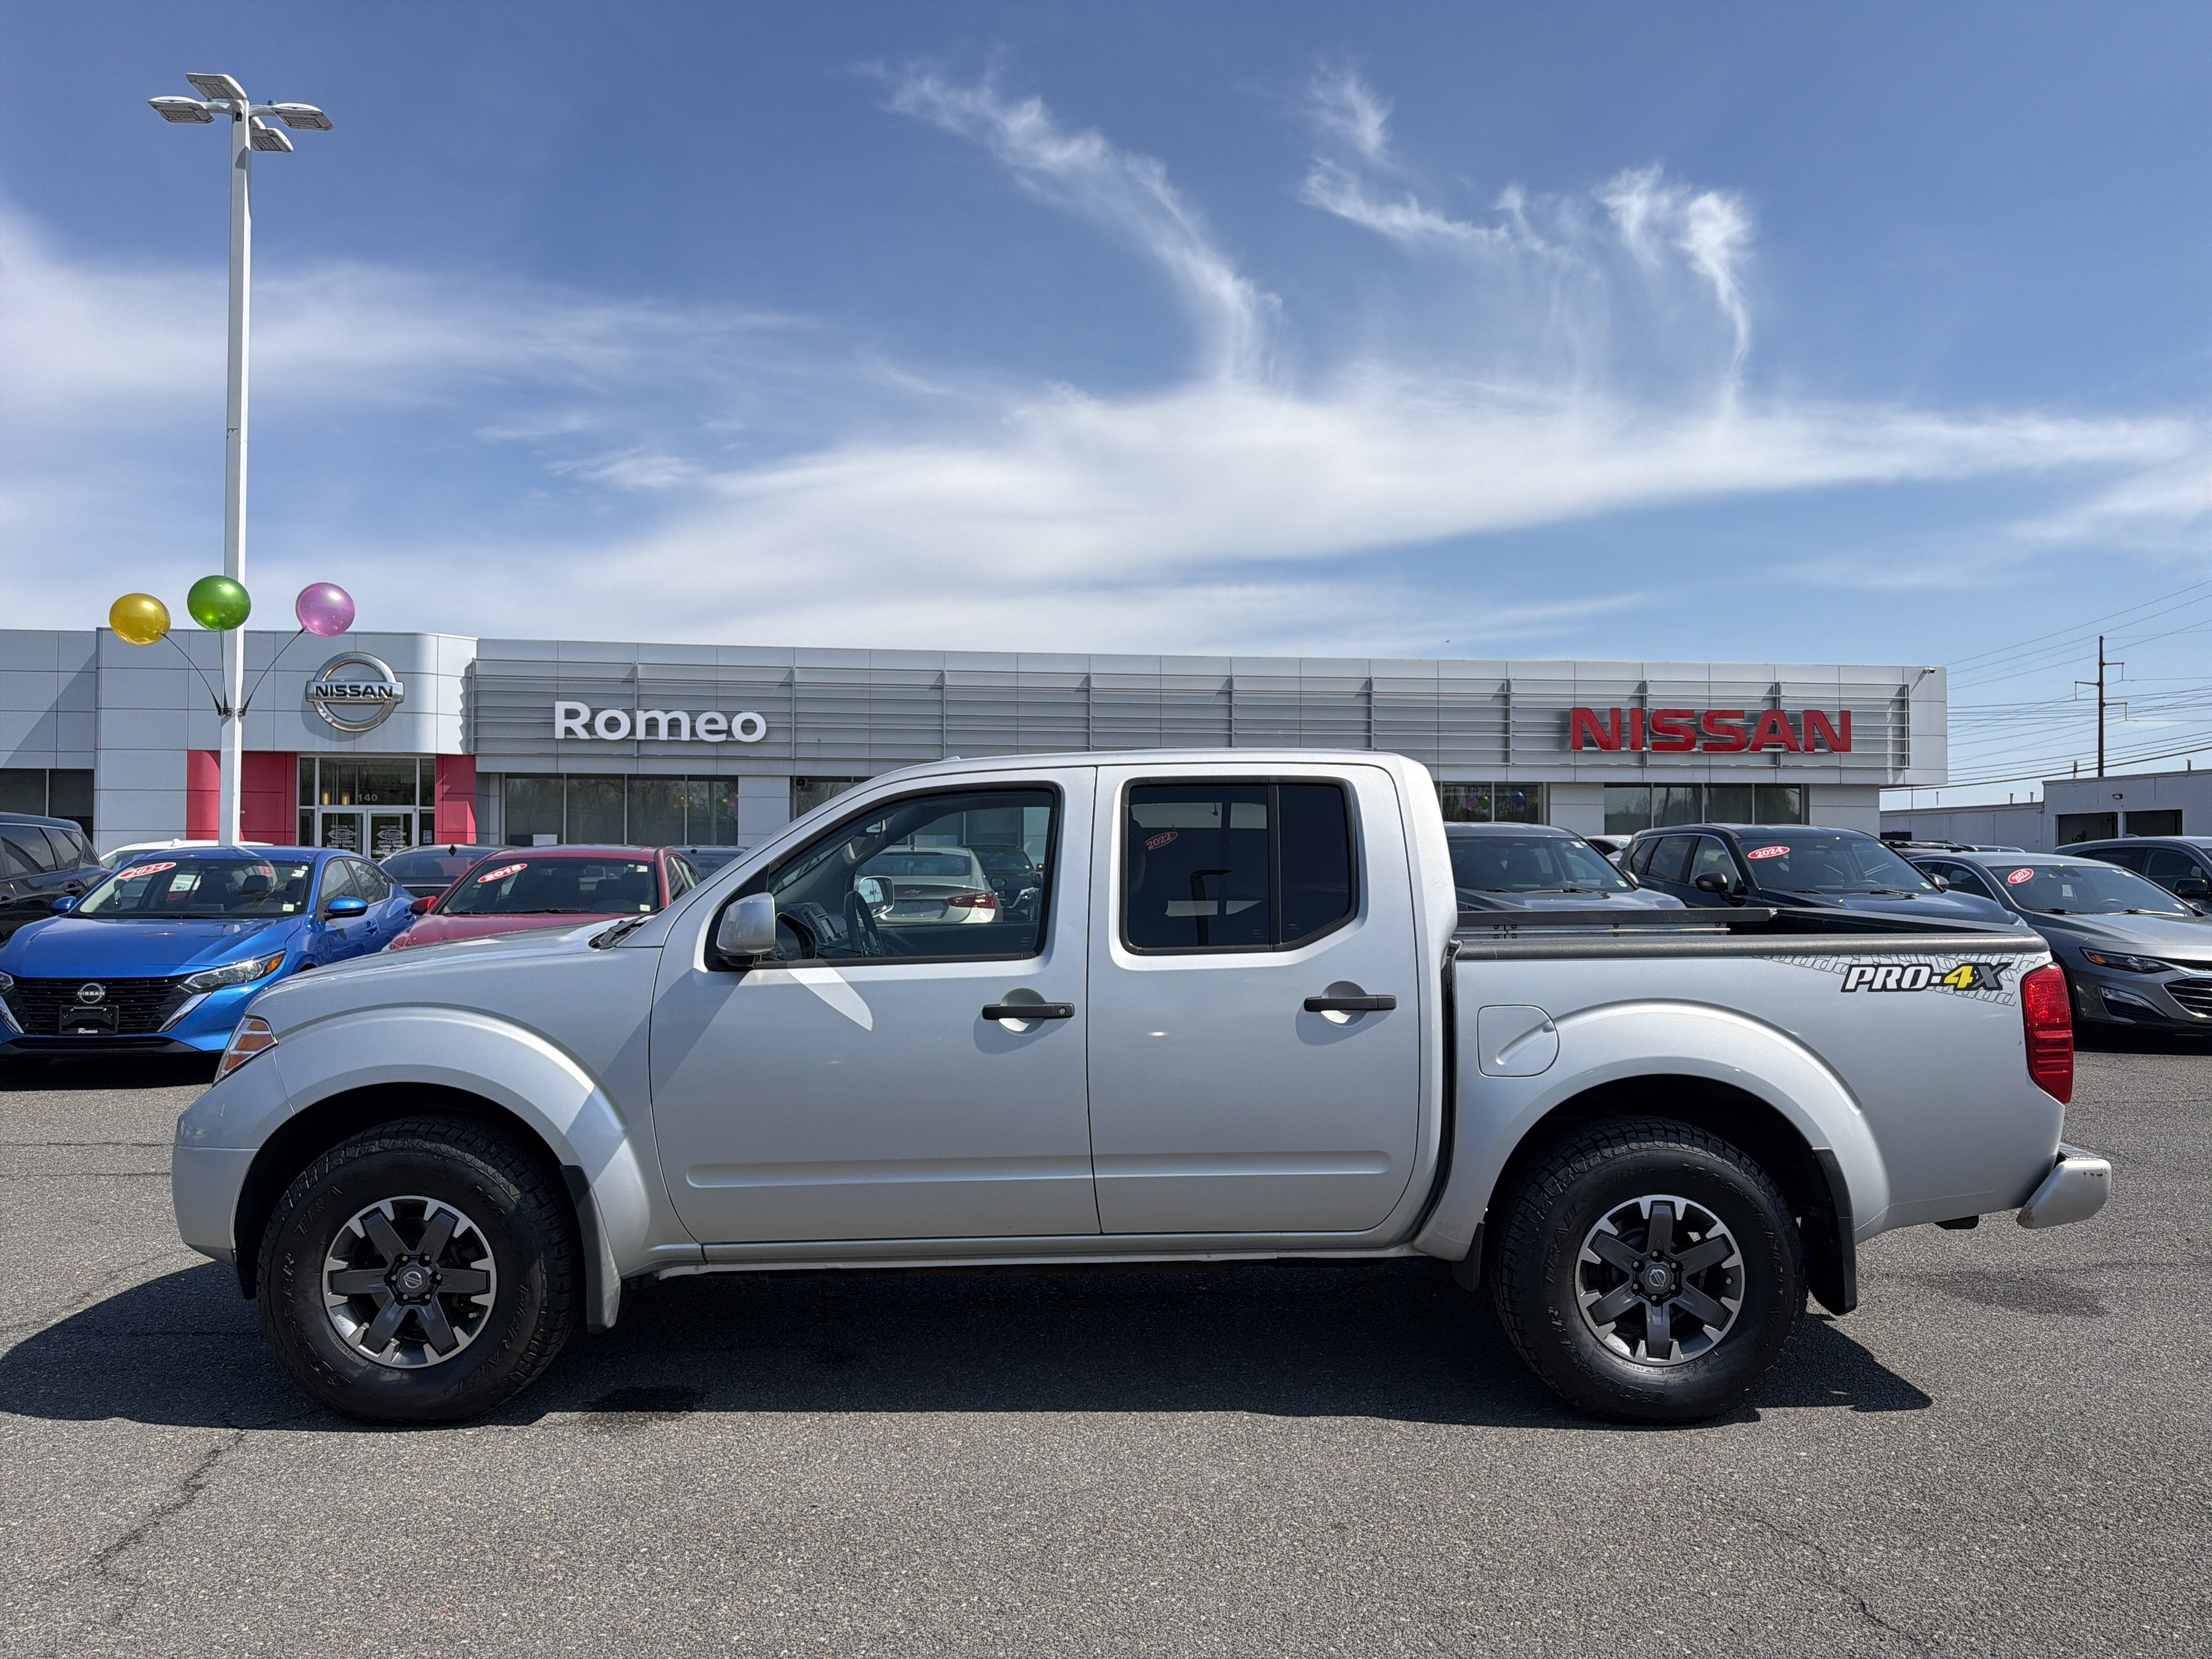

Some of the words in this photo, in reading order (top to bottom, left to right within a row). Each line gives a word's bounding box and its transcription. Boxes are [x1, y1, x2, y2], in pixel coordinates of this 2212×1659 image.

[315, 685, 393, 697] NISSAN
[554, 700, 766, 742] Romeo
[1570, 707, 1852, 753] NISSAN
[1147, 833, 1172, 849] 2022
[1755, 847, 1783, 858] 2024
[484, 864, 522, 882] 2018
[2011, 870, 2030, 882] 2023
[1841, 963, 2013, 992] PRO-4X
